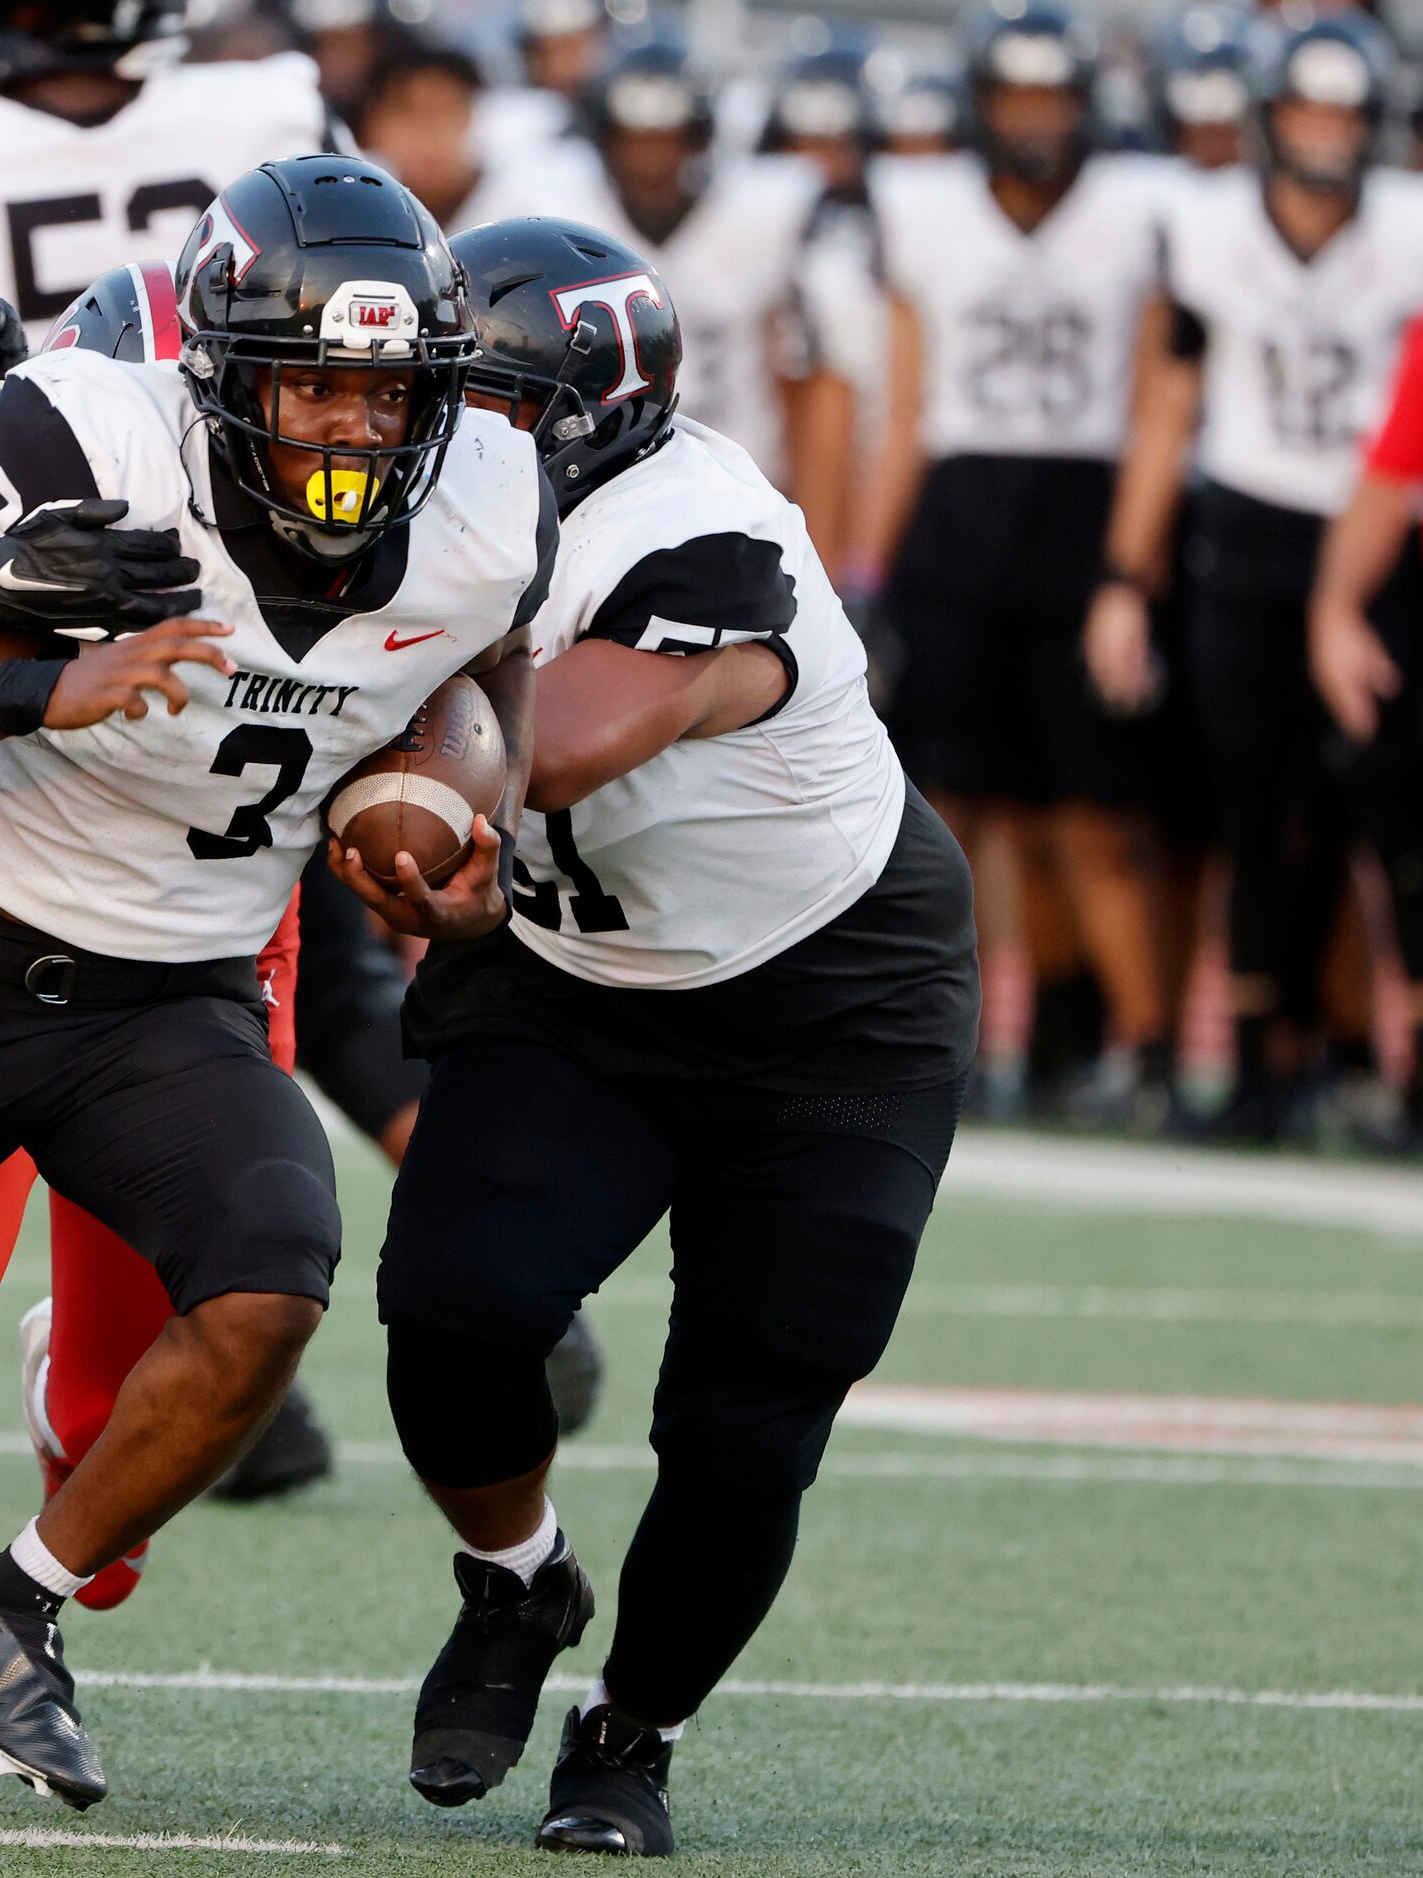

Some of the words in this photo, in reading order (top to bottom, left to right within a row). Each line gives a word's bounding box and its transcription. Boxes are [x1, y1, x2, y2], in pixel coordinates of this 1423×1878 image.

[548, 269, 665, 407] T
[223, 670, 360, 717] TRINITY
[186, 723, 314, 860] 3
